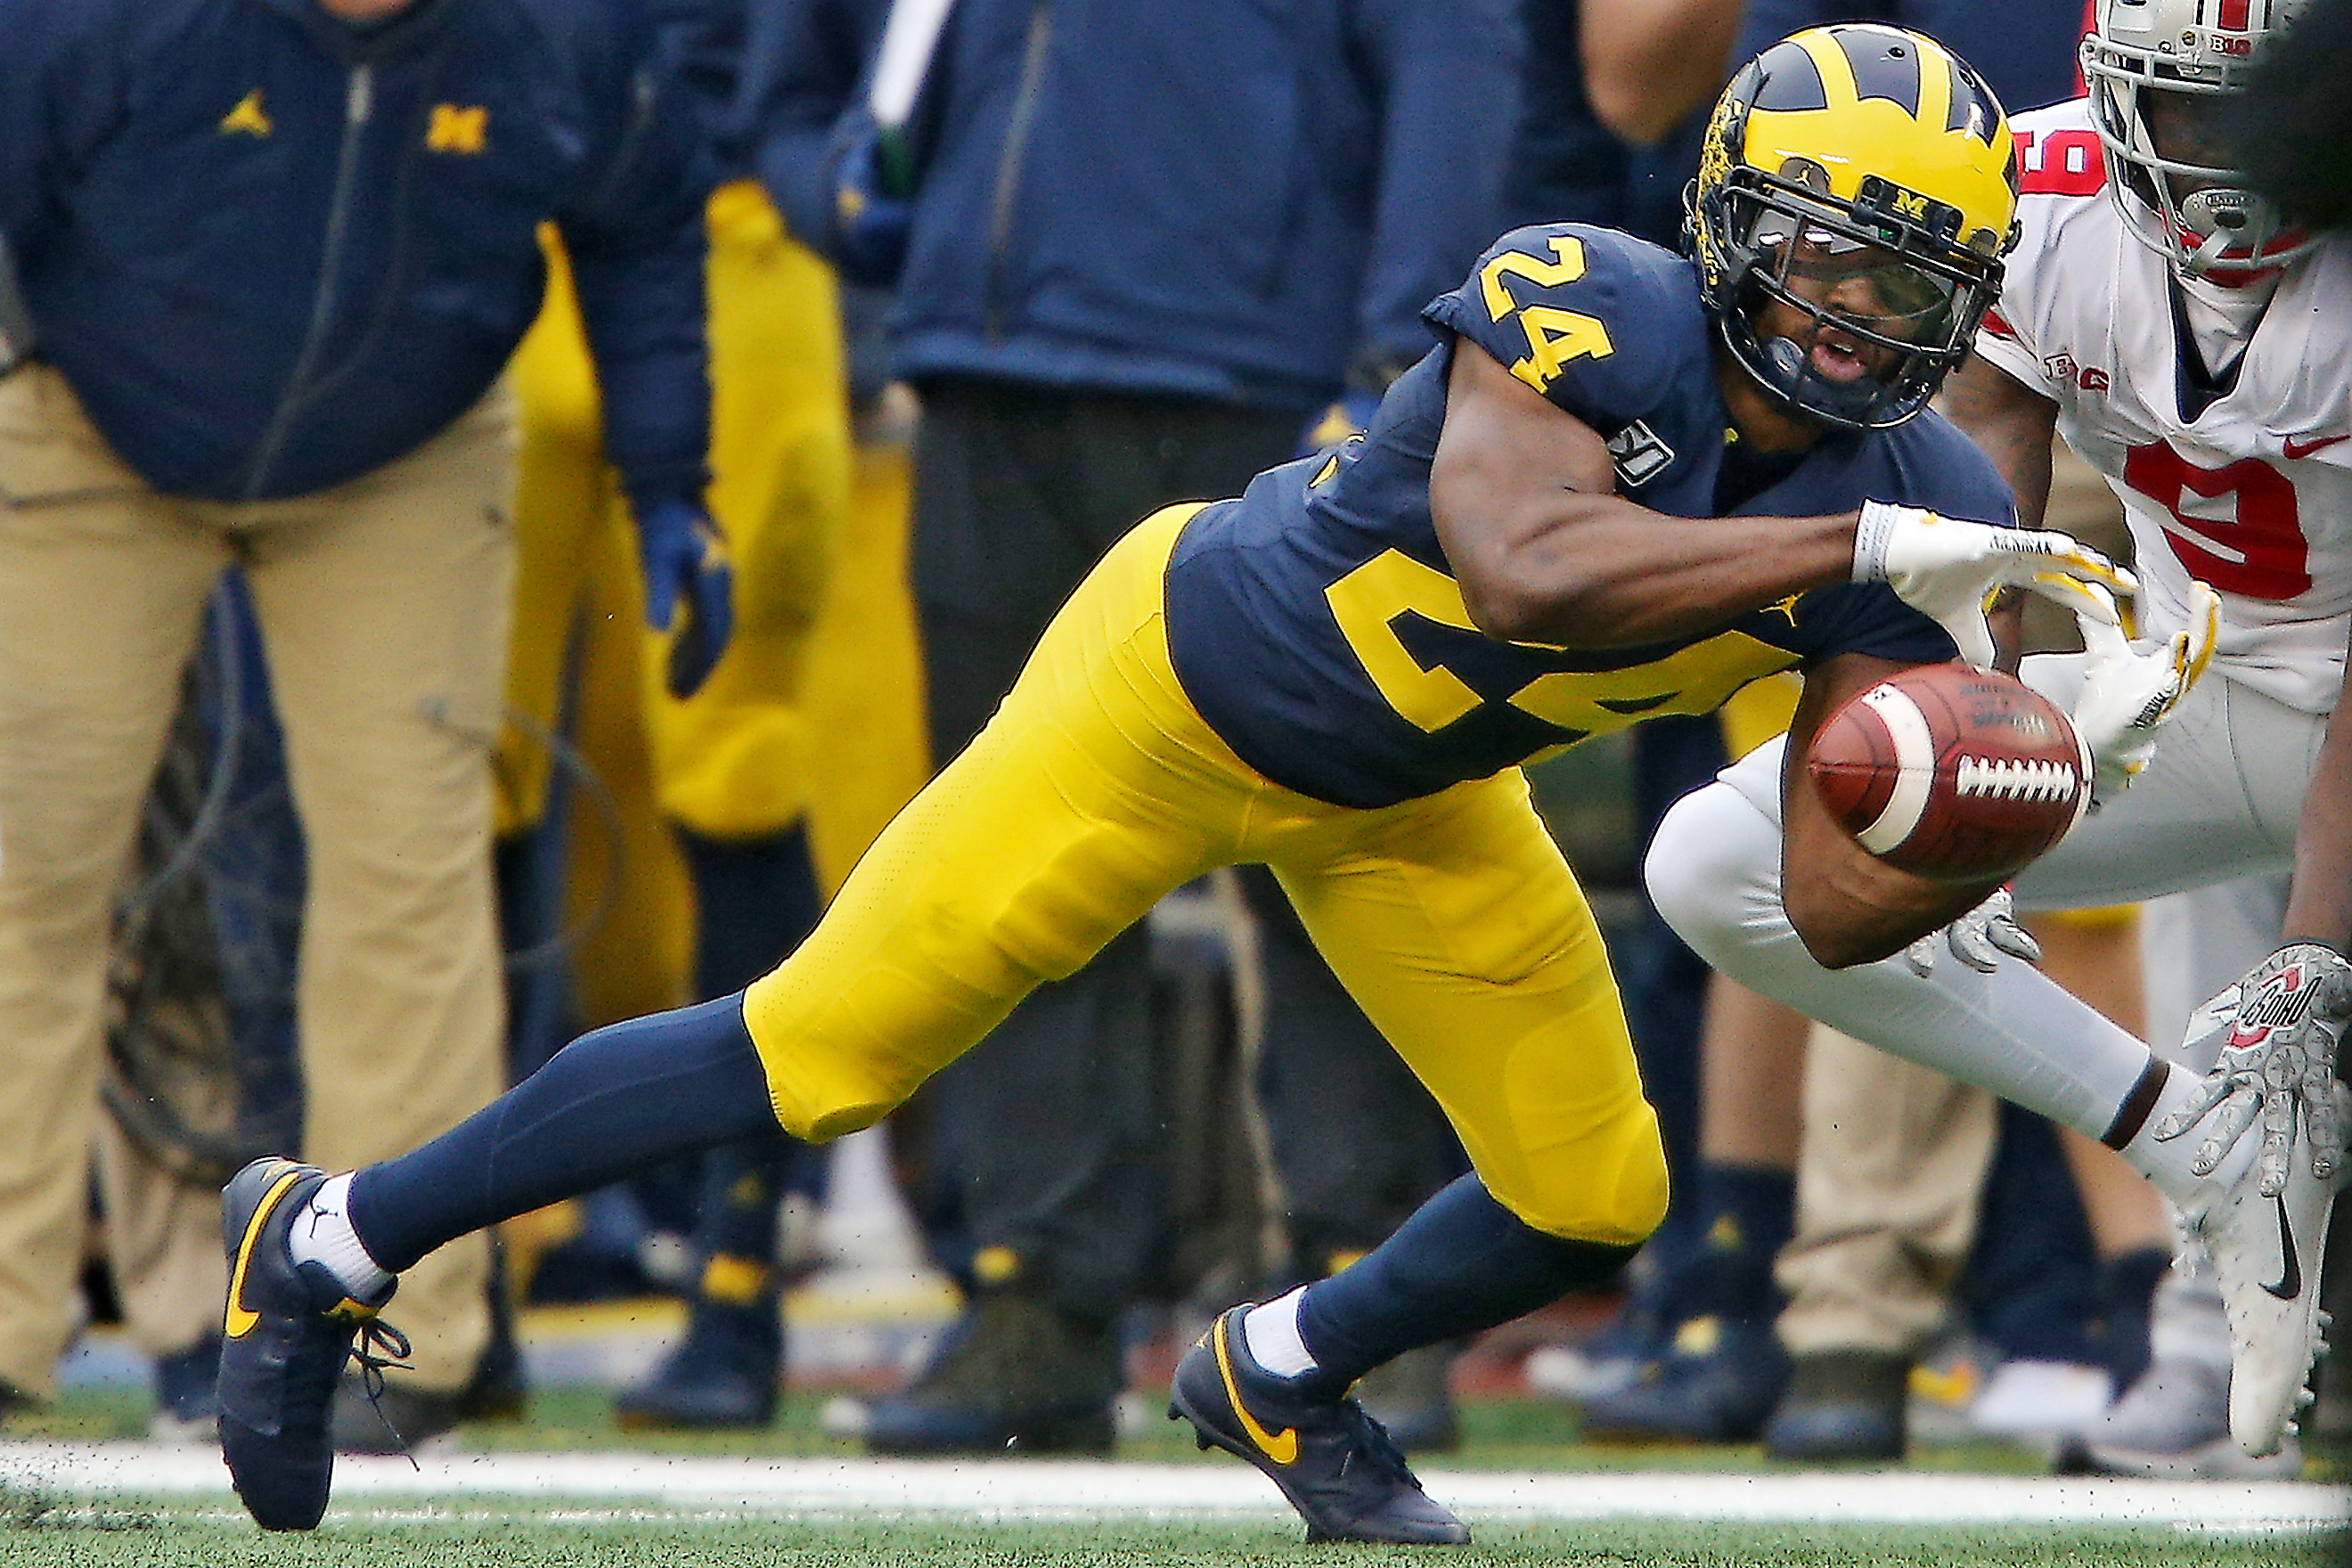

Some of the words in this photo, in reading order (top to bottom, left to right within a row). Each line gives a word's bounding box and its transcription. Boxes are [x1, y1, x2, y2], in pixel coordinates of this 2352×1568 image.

[1891, 188, 1930, 222] M
[1479, 234, 1615, 394] 24
[2125, 439, 2312, 600] 9
